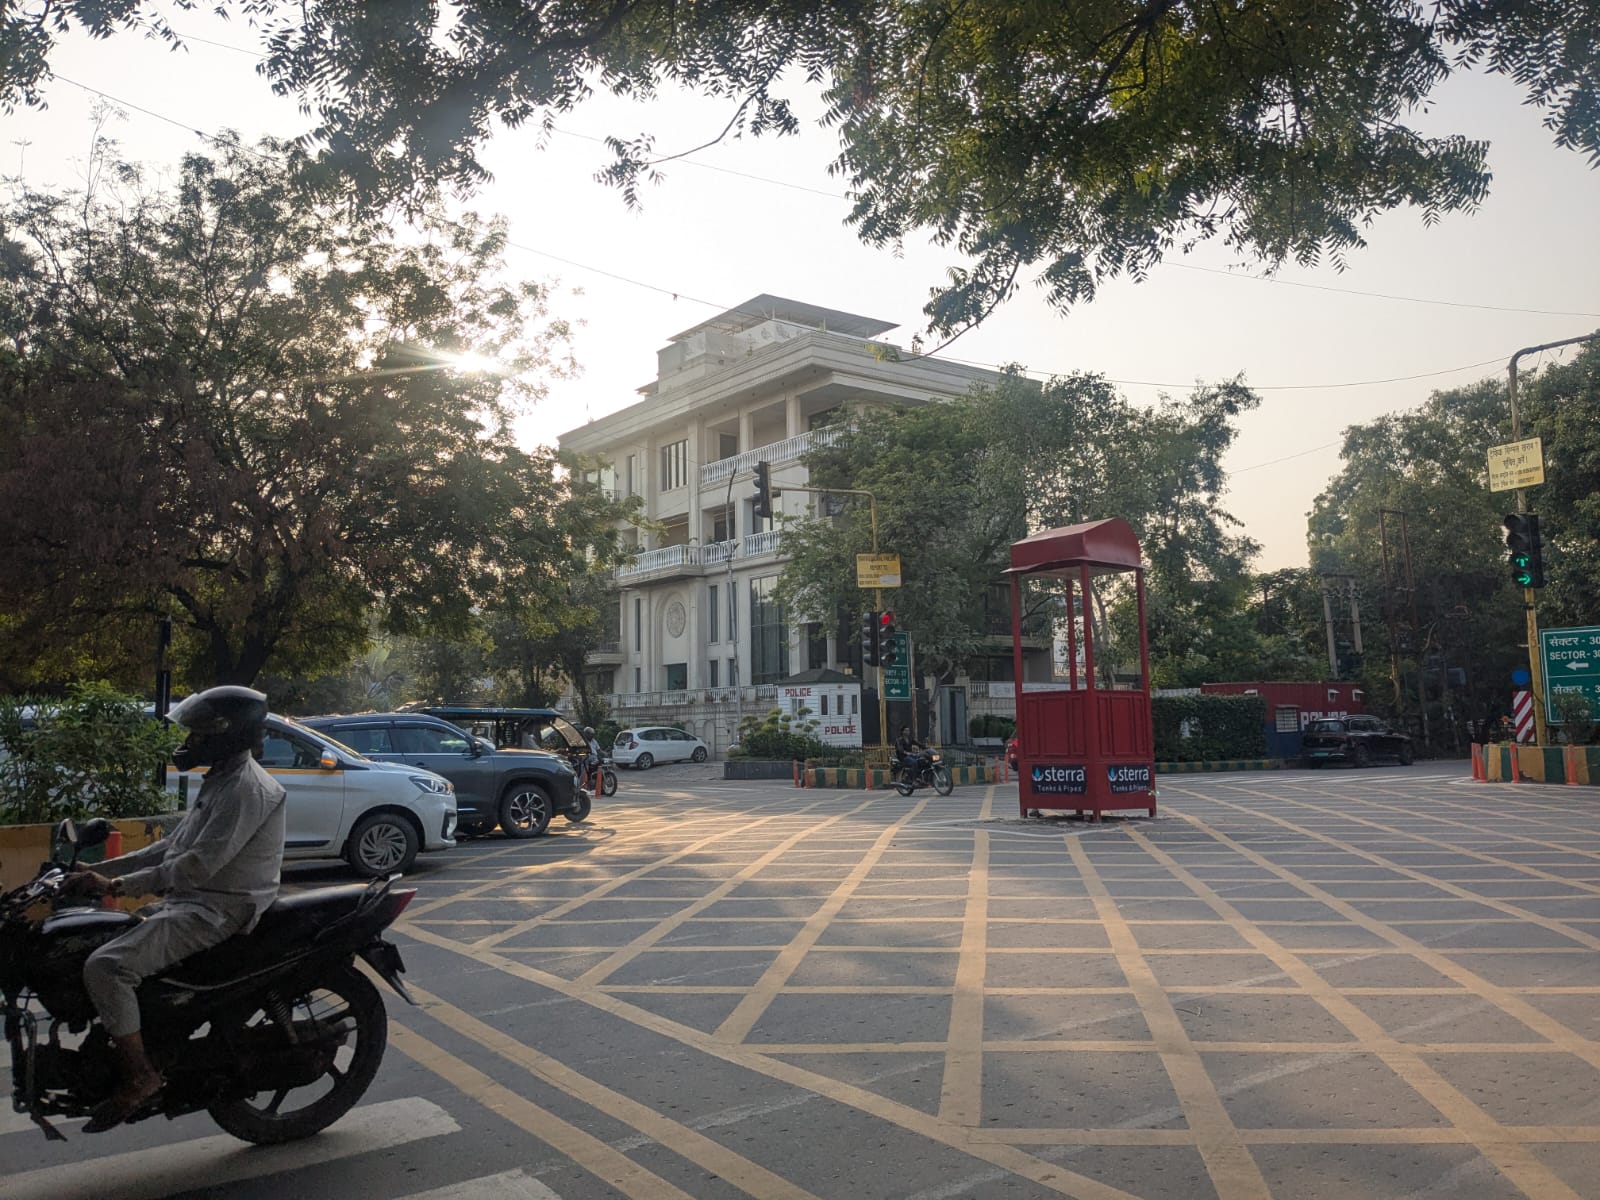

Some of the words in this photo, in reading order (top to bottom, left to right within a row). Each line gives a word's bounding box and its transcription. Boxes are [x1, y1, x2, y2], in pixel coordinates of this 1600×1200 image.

[785, 688, 811, 697] POLICE
[824, 725, 856, 735] POLICE
[1044, 766, 1084, 781] sterra
[1118, 766, 1149, 781] sterra
